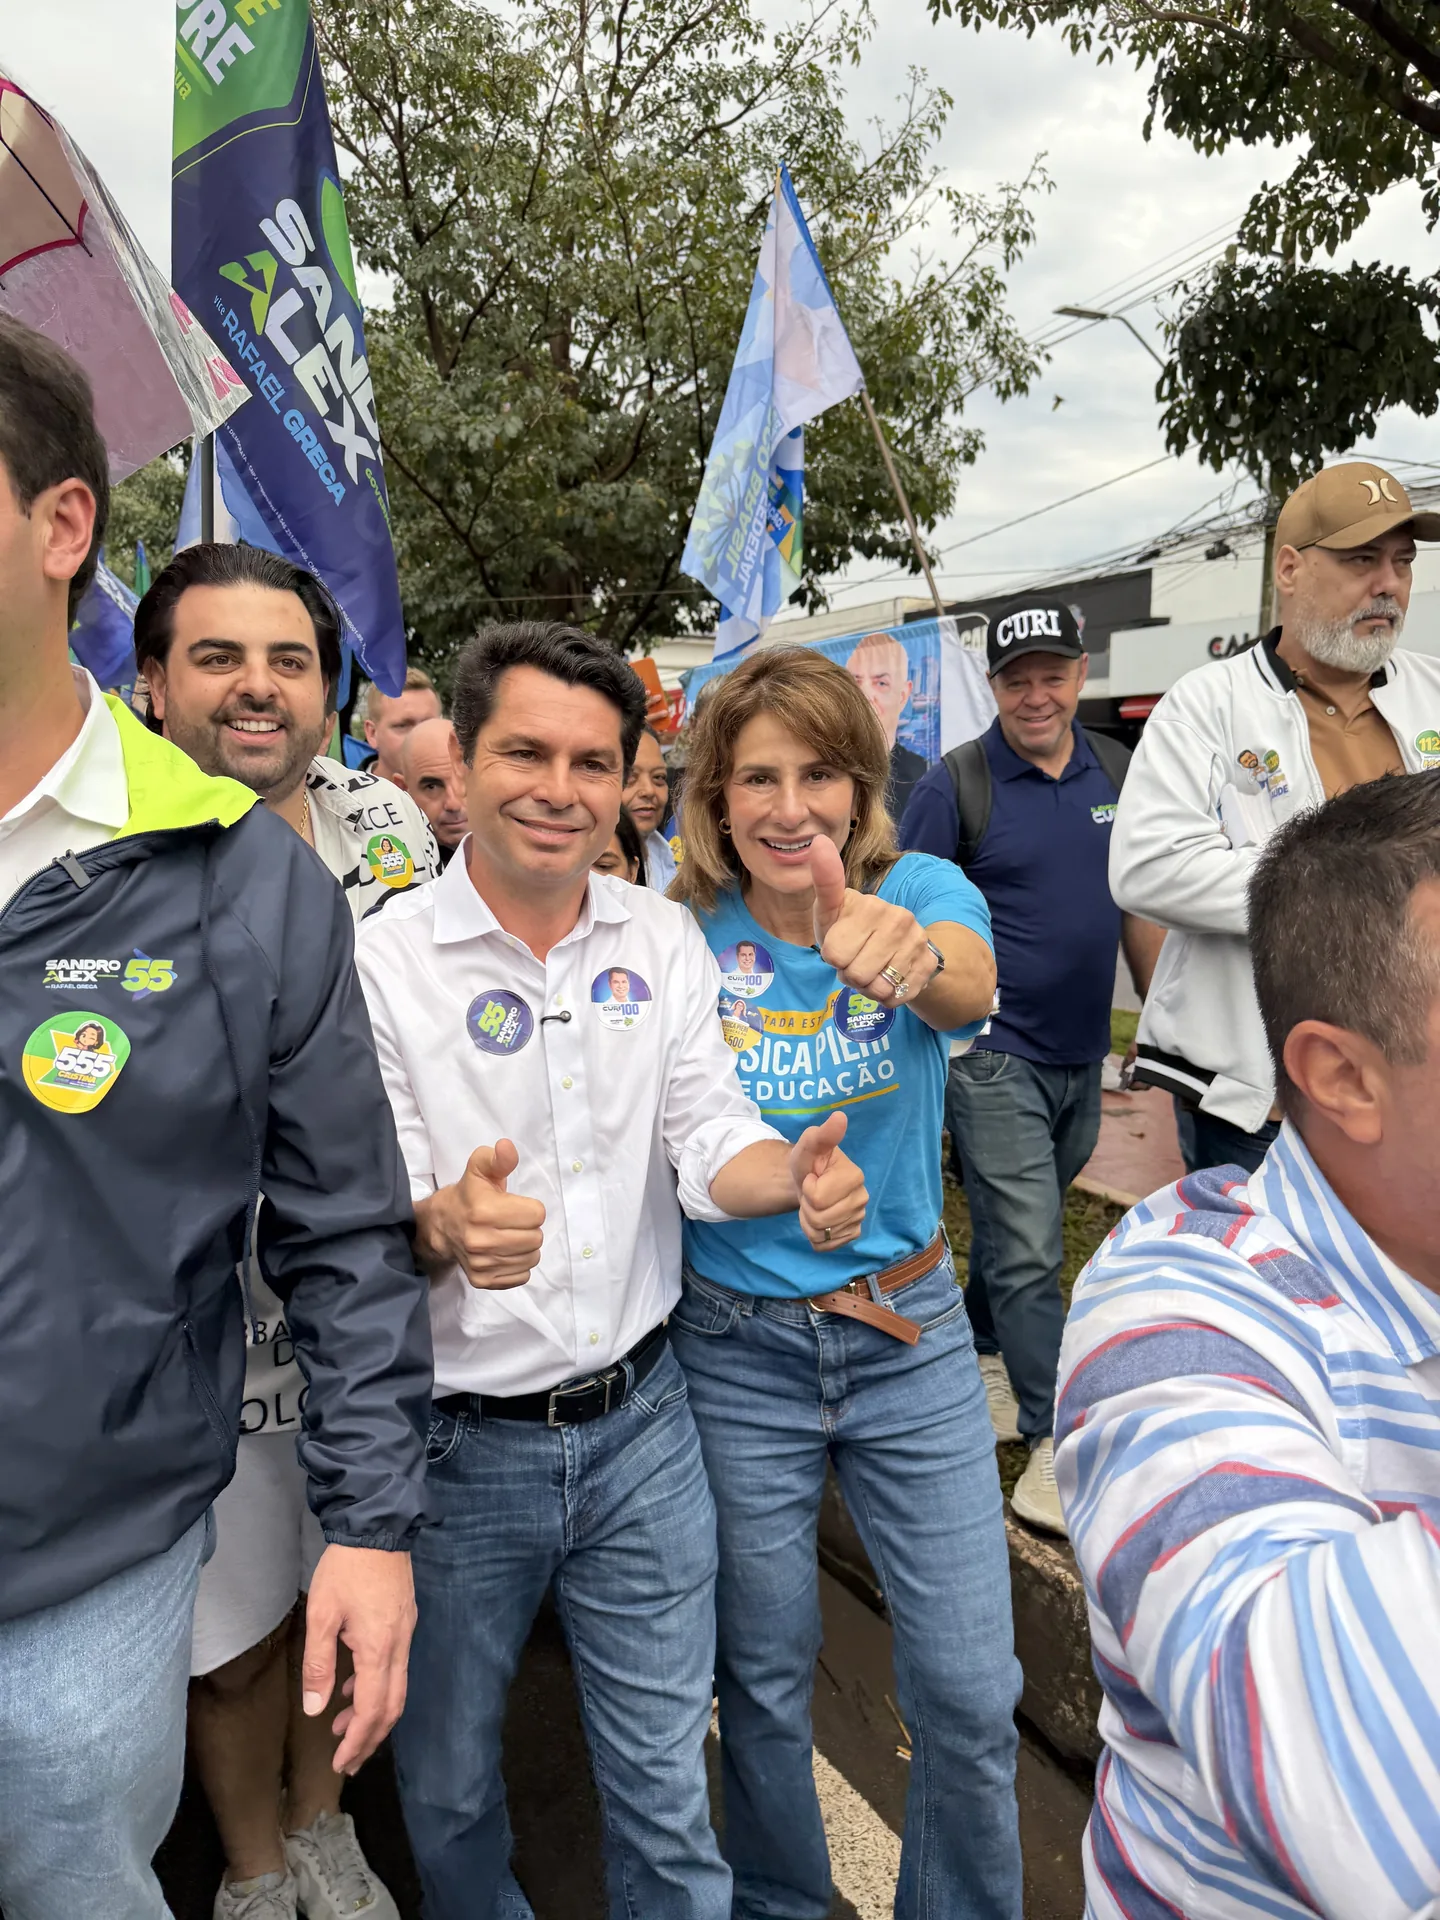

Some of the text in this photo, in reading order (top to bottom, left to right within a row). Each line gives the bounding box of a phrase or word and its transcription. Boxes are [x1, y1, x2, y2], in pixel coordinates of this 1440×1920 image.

[176, 0, 256, 86] RE
[213, 294, 227, 316] vice
[218, 249, 377, 486] ALEX
[221, 308, 287, 415] RAFAEL
[282, 408, 347, 507] GRECA
[996, 608, 1062, 648] CURI
[43, 970, 99, 983] ALEX
[45, 958, 175, 992] SANDRO 55
[745, 974, 763, 986] 100
[478, 1000, 507, 1038] 55
[620, 1003, 640, 1016] 100
[846, 1012, 886, 1024] SANDRO
[846, 1019, 876, 1031] ALEX
[55, 1046, 116, 1078] 555
[740, 1059, 895, 1102] EDUCAÇÃO
